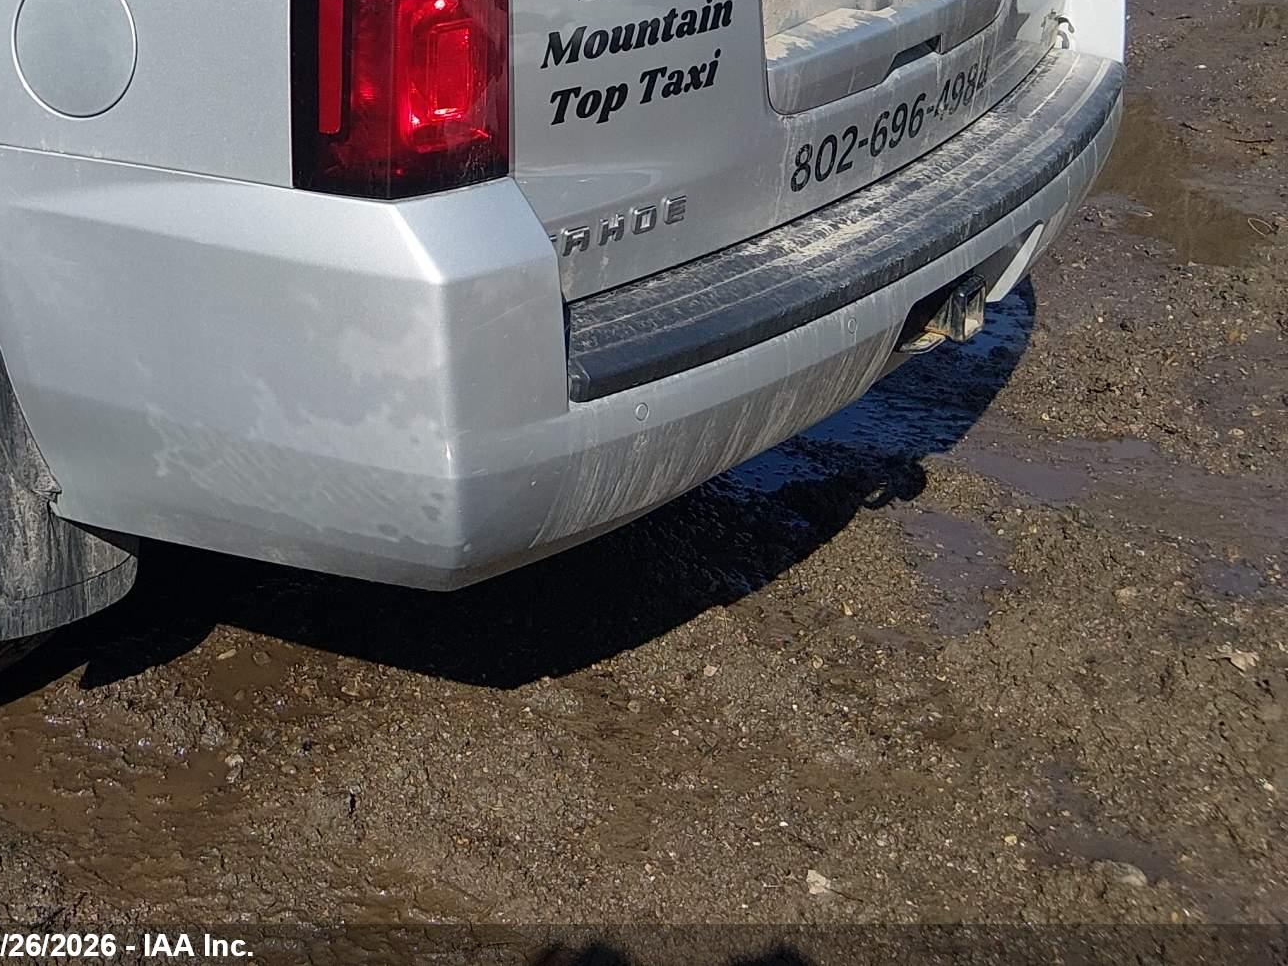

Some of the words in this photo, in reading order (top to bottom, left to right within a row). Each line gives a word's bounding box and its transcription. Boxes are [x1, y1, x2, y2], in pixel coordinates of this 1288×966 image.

[550, 84, 628, 126] Top
[639, 49, 722, 104] Taxi
[790, 54, 990, 193] 802-696-4984
[549, 194, 688, 257] AHOE
